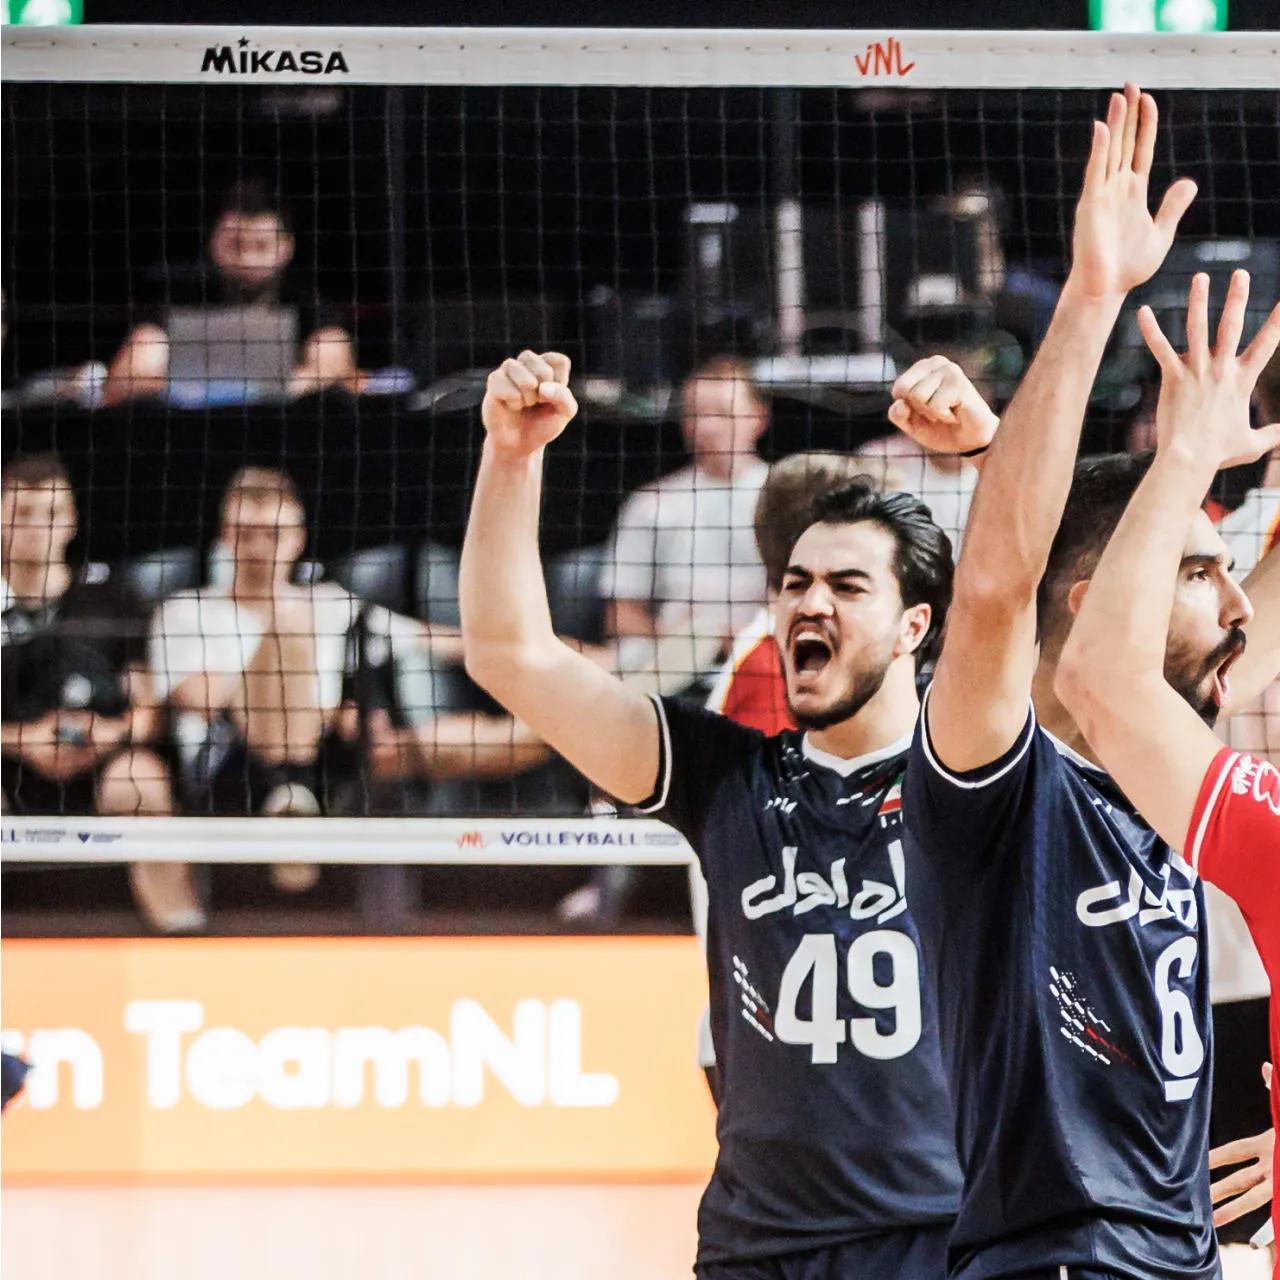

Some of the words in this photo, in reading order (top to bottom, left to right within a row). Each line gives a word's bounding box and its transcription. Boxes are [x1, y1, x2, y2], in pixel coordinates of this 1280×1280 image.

[500, 831, 637, 846] VOLLEYBALL
[123, 998, 619, 1111] TeamNL
[775, 929, 922, 1065] 49
[1154, 935, 1205, 1079] 6
